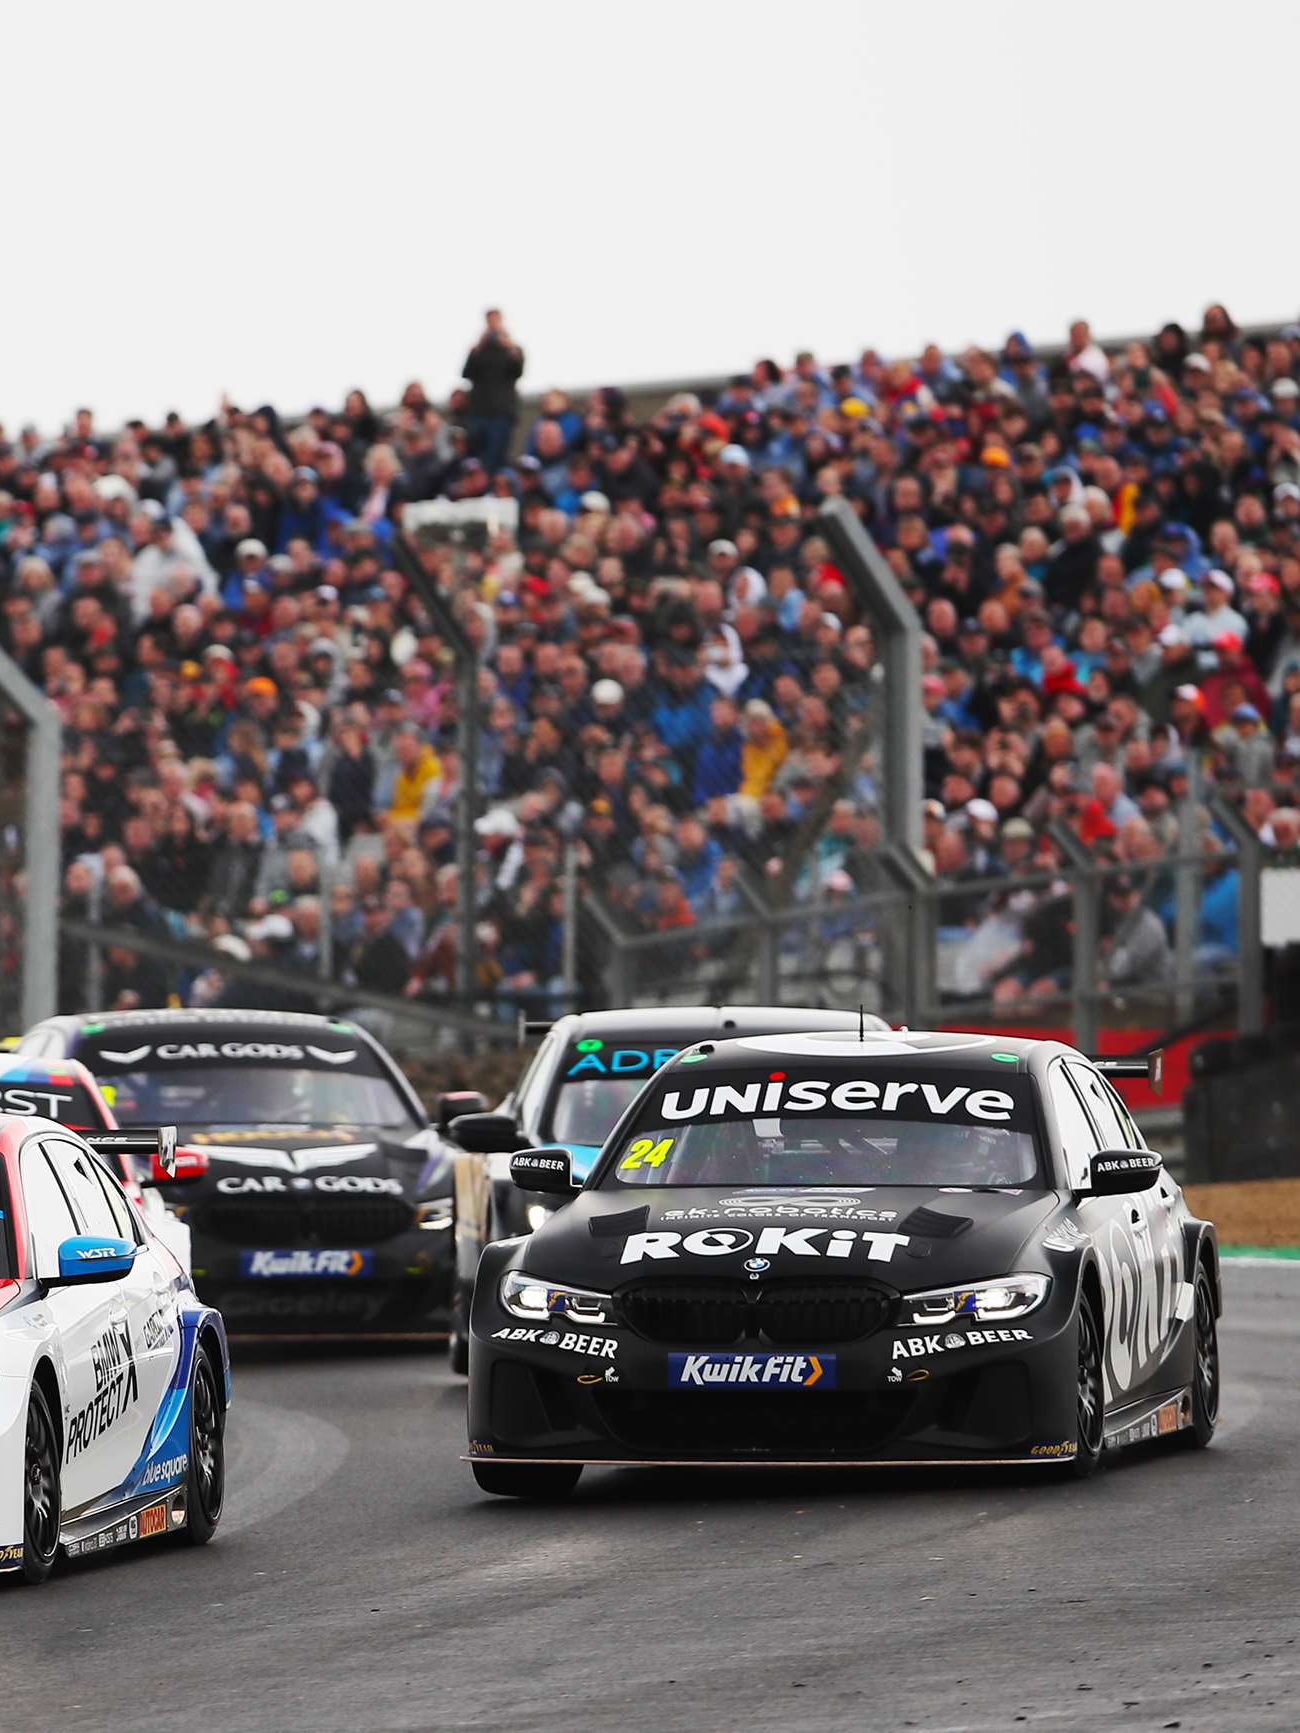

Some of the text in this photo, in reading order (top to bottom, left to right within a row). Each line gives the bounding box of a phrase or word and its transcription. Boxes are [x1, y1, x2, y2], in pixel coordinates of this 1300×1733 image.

[156, 1042, 305, 1061] CAR GODS
[619, 1138, 674, 1169] 24
[512, 1157, 564, 1171] ABK BEER
[1097, 1157, 1154, 1173] ABK BEER
[216, 1175, 404, 1195] CAR GODS
[76, 1247, 117, 1259] WSR
[491, 1327, 619, 1359] ABK BEER
[892, 1329, 1034, 1360] ABK BEER
[605, 1374, 620, 1383] TOW
[887, 1375, 902, 1383] TOW
[66, 1372, 124, 1465] PROTECT
